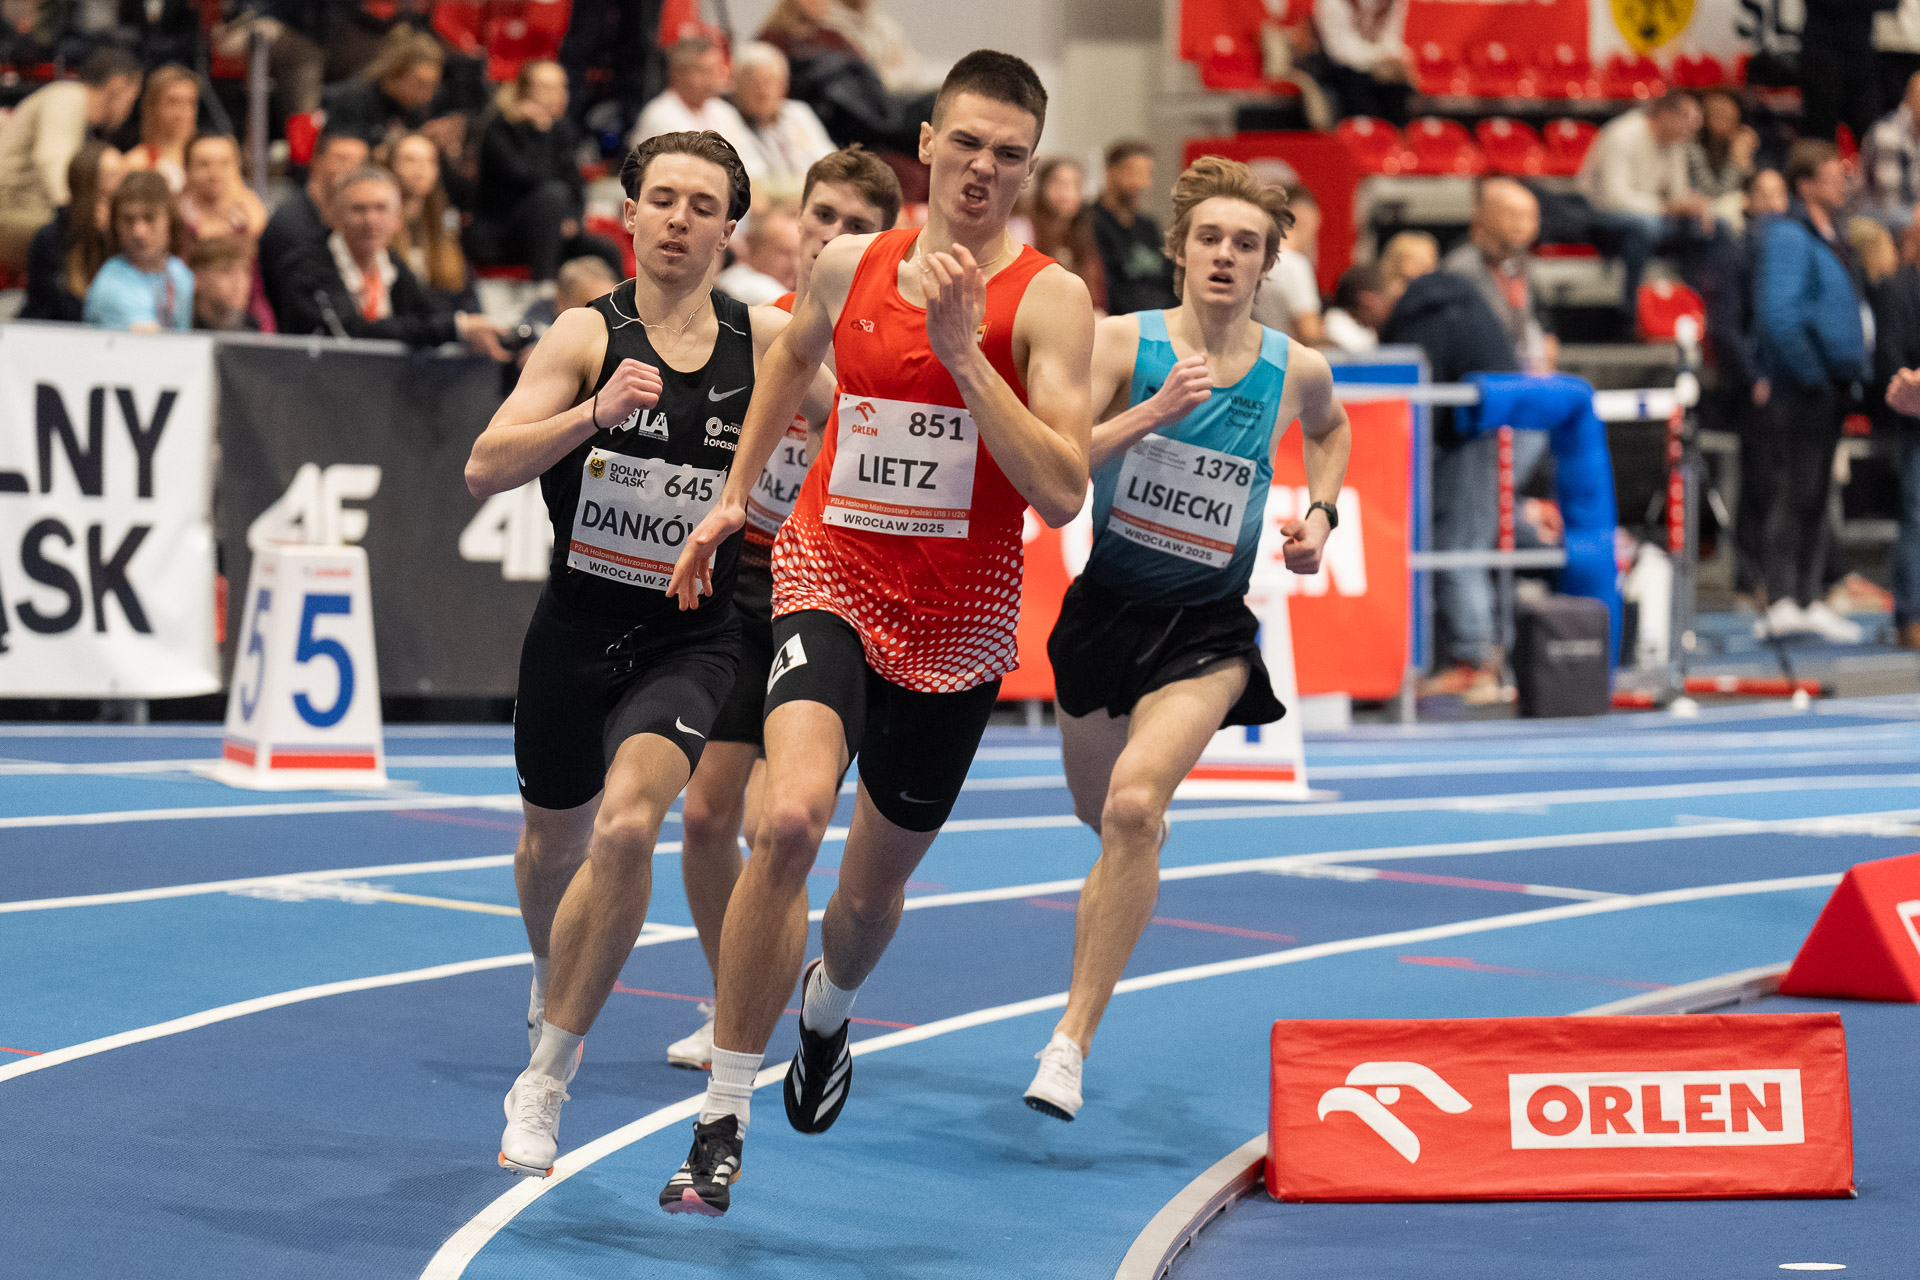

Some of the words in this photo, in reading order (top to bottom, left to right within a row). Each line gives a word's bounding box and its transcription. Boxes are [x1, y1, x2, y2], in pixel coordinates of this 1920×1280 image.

[852, 424, 878, 437] ORLEN
[908, 411, 964, 441] 851
[608, 472, 645, 489] ŚLĄSK
[610, 463, 650, 479] DOLNY
[858, 453, 939, 490] LIETZ
[1192, 455, 1251, 487] 1378
[664, 474, 713, 502] 645
[1127, 475, 1233, 527] LISIECKI
[246, 462, 383, 548] 4F
[830, 497, 844, 505] PZLA
[845, 500, 869, 509] Halowe
[869, 503, 909, 515] Mistrzostwa
[843, 513, 909, 532] WROCŁAW
[911, 522, 945, 533] 2025
[574, 543, 589, 553] PZLA
[590, 549, 616, 561] Halowe
[615, 555, 657, 570] Mistrzostwa
[658, 564, 674, 573] Pols
[1124, 526, 1184, 553] WROCŁAW
[1185, 546, 1213, 561] 2025
[0, 517, 153, 654] SK
[589, 561, 657, 585] WROCŁAW
[240, 589, 271, 722] 5
[293, 593, 355, 728] 5
[772, 645, 794, 680] 4
[1526, 1082, 1784, 1137] ORLEN
